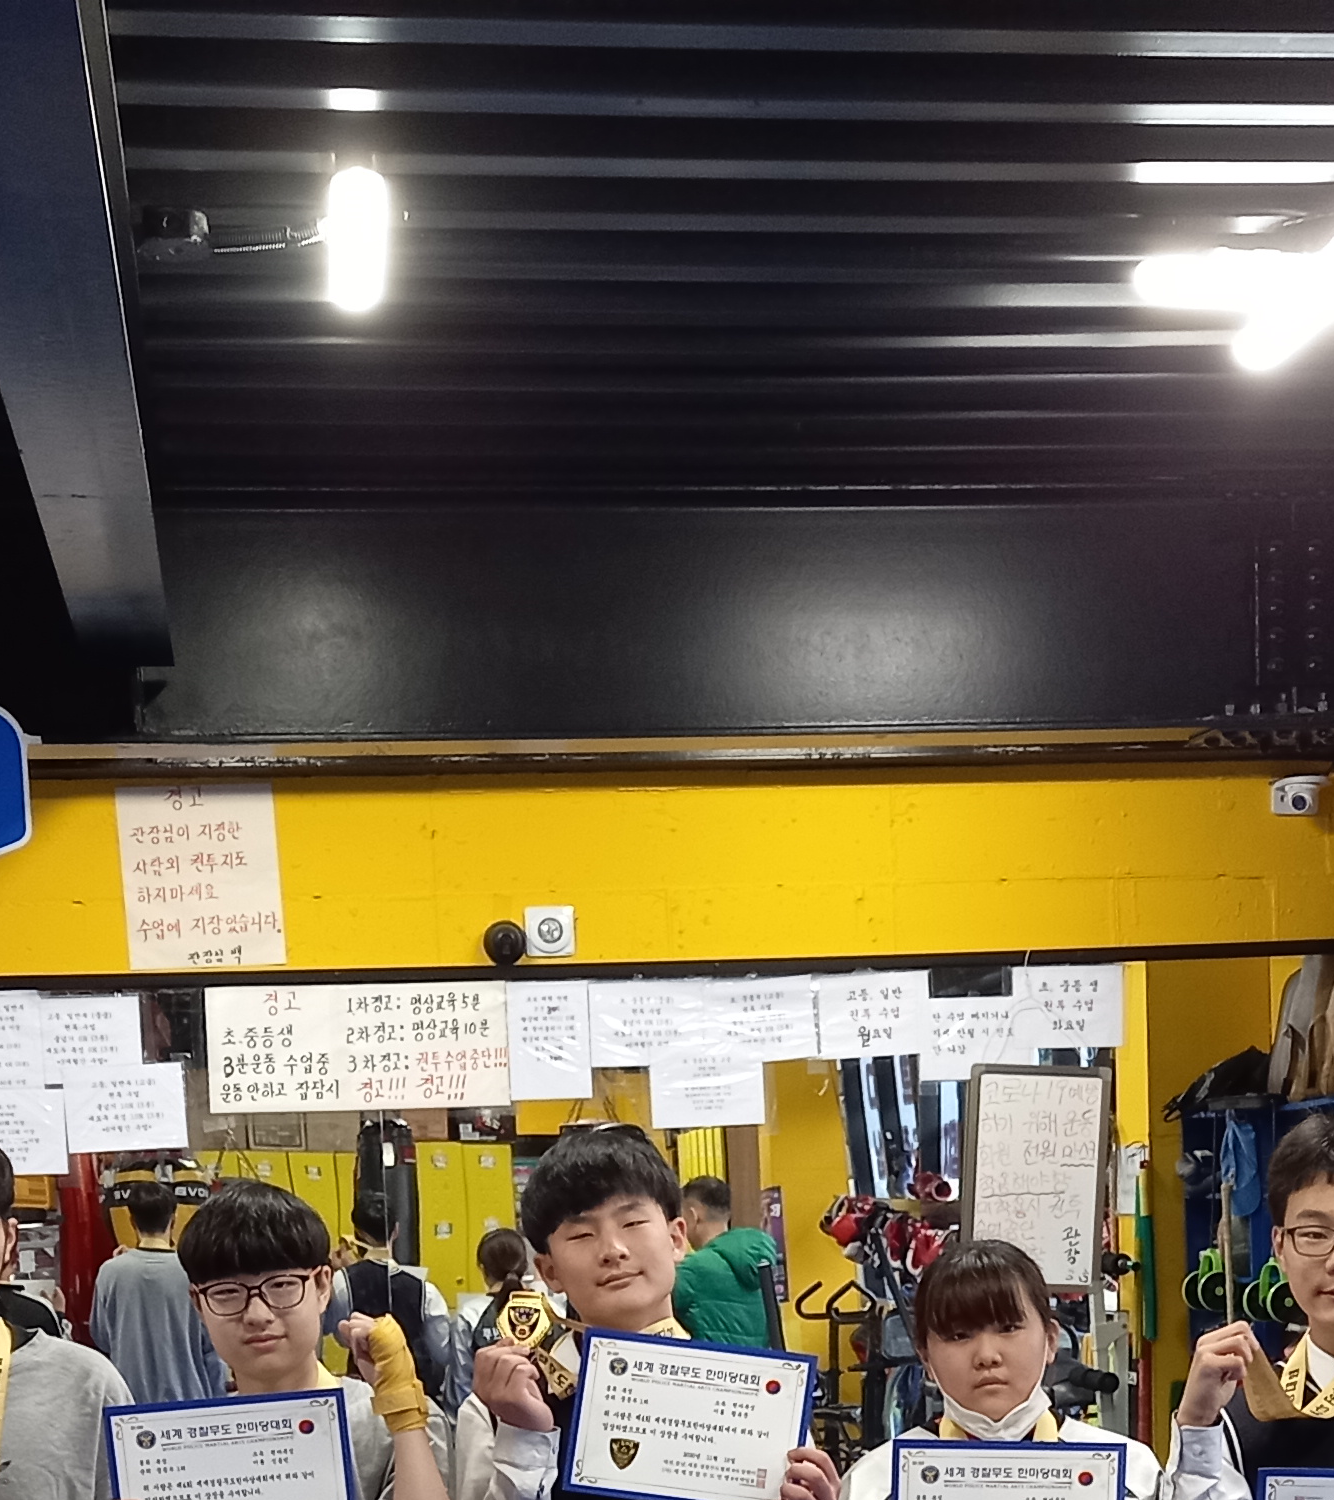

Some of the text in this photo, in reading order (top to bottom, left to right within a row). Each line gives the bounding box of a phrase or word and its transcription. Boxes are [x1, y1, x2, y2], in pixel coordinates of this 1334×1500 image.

[130, 824, 190, 845] 관장님이
[136, 918, 181, 942] 수업에
[632, 1360, 655, 1373] 세계
[160, 1428, 183, 1441] 세계
[944, 1466, 966, 1478] 세계
